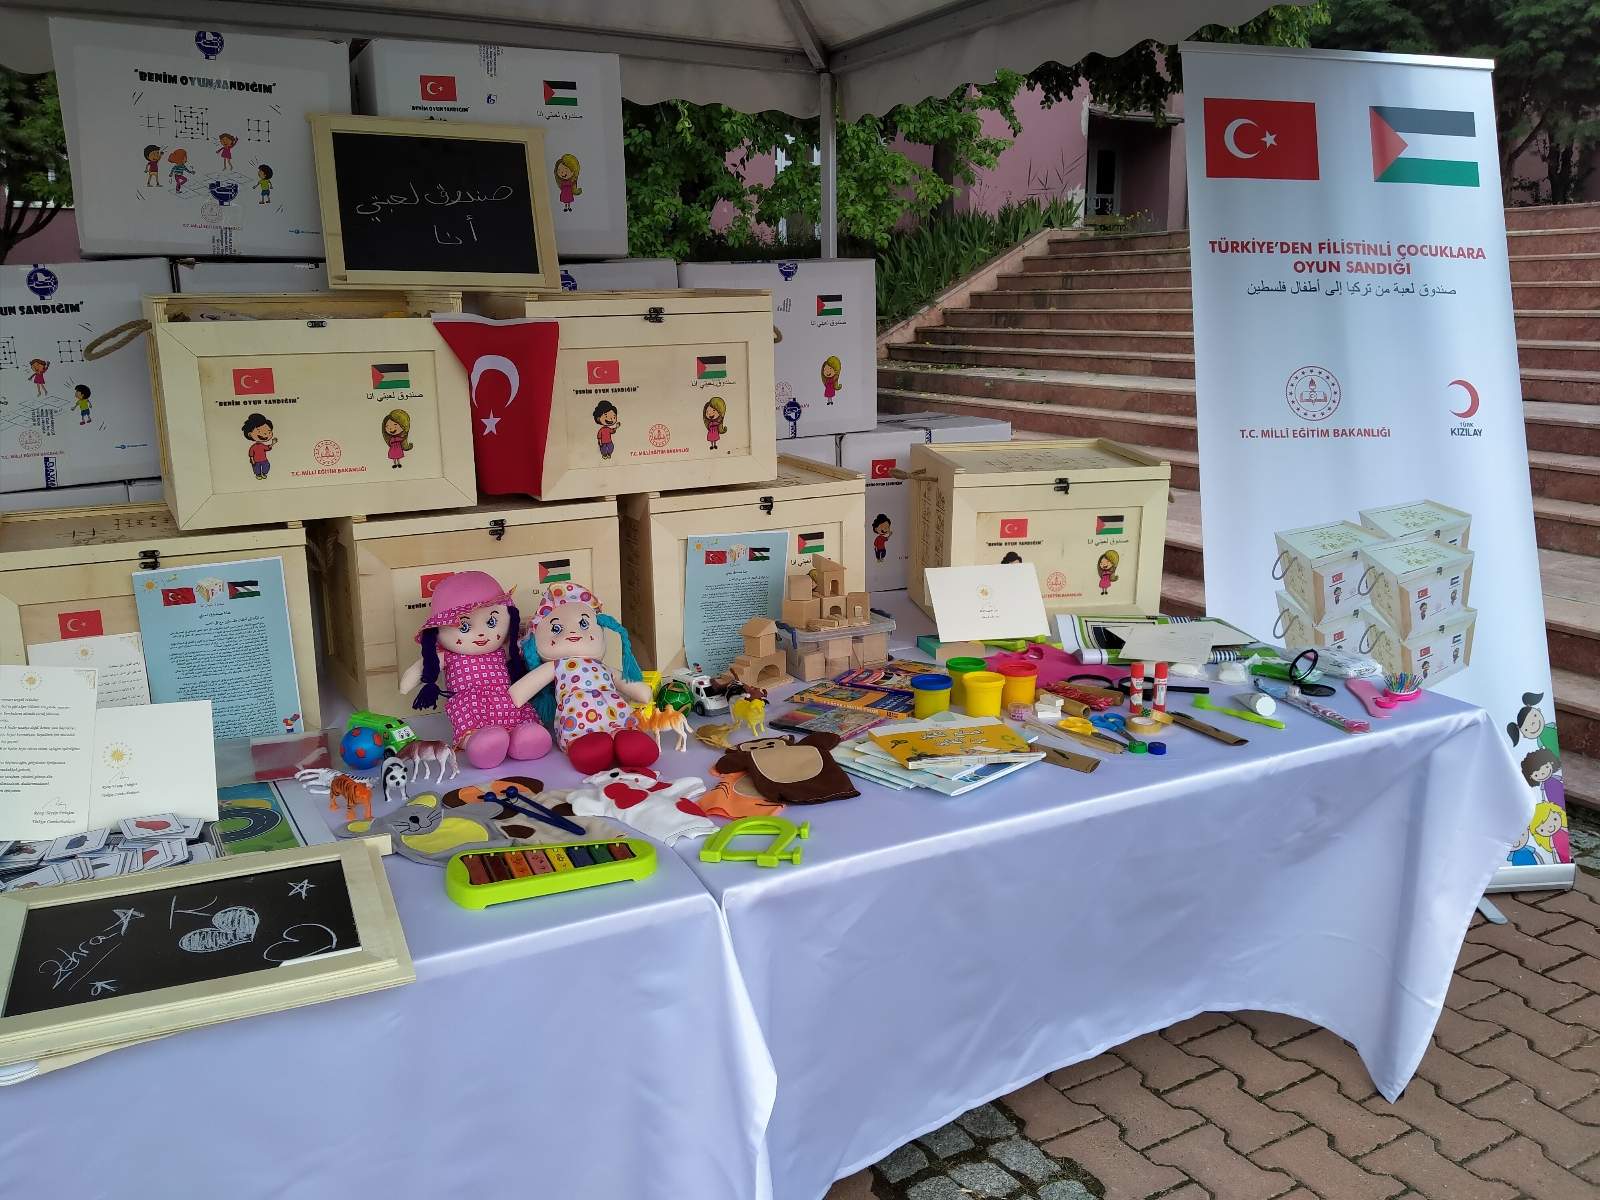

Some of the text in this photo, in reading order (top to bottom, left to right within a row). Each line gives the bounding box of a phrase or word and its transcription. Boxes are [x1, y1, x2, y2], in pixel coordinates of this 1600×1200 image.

[179, 75, 213, 88] OYUN
[356, 182, 513, 222] صندوق لعبتي
[1208, 237, 1487, 260] TÜRKİYE'DEN FİLİSTİNLİ ÇOCUKLARA
[1293, 259, 1412, 275] OYUN SANDIĞI
[1247, 279, 1457, 297] صندوق لعبة من تركيا إلى أطفال فلسطين
[398, 392, 424, 401] صندوق
[1239, 429, 1259, 439] T.C.
[1292, 427, 1330, 439] EĞİTİM
[1333, 427, 1391, 438] BAKANLIĞI
[1450, 427, 1483, 437] KIZILAY
